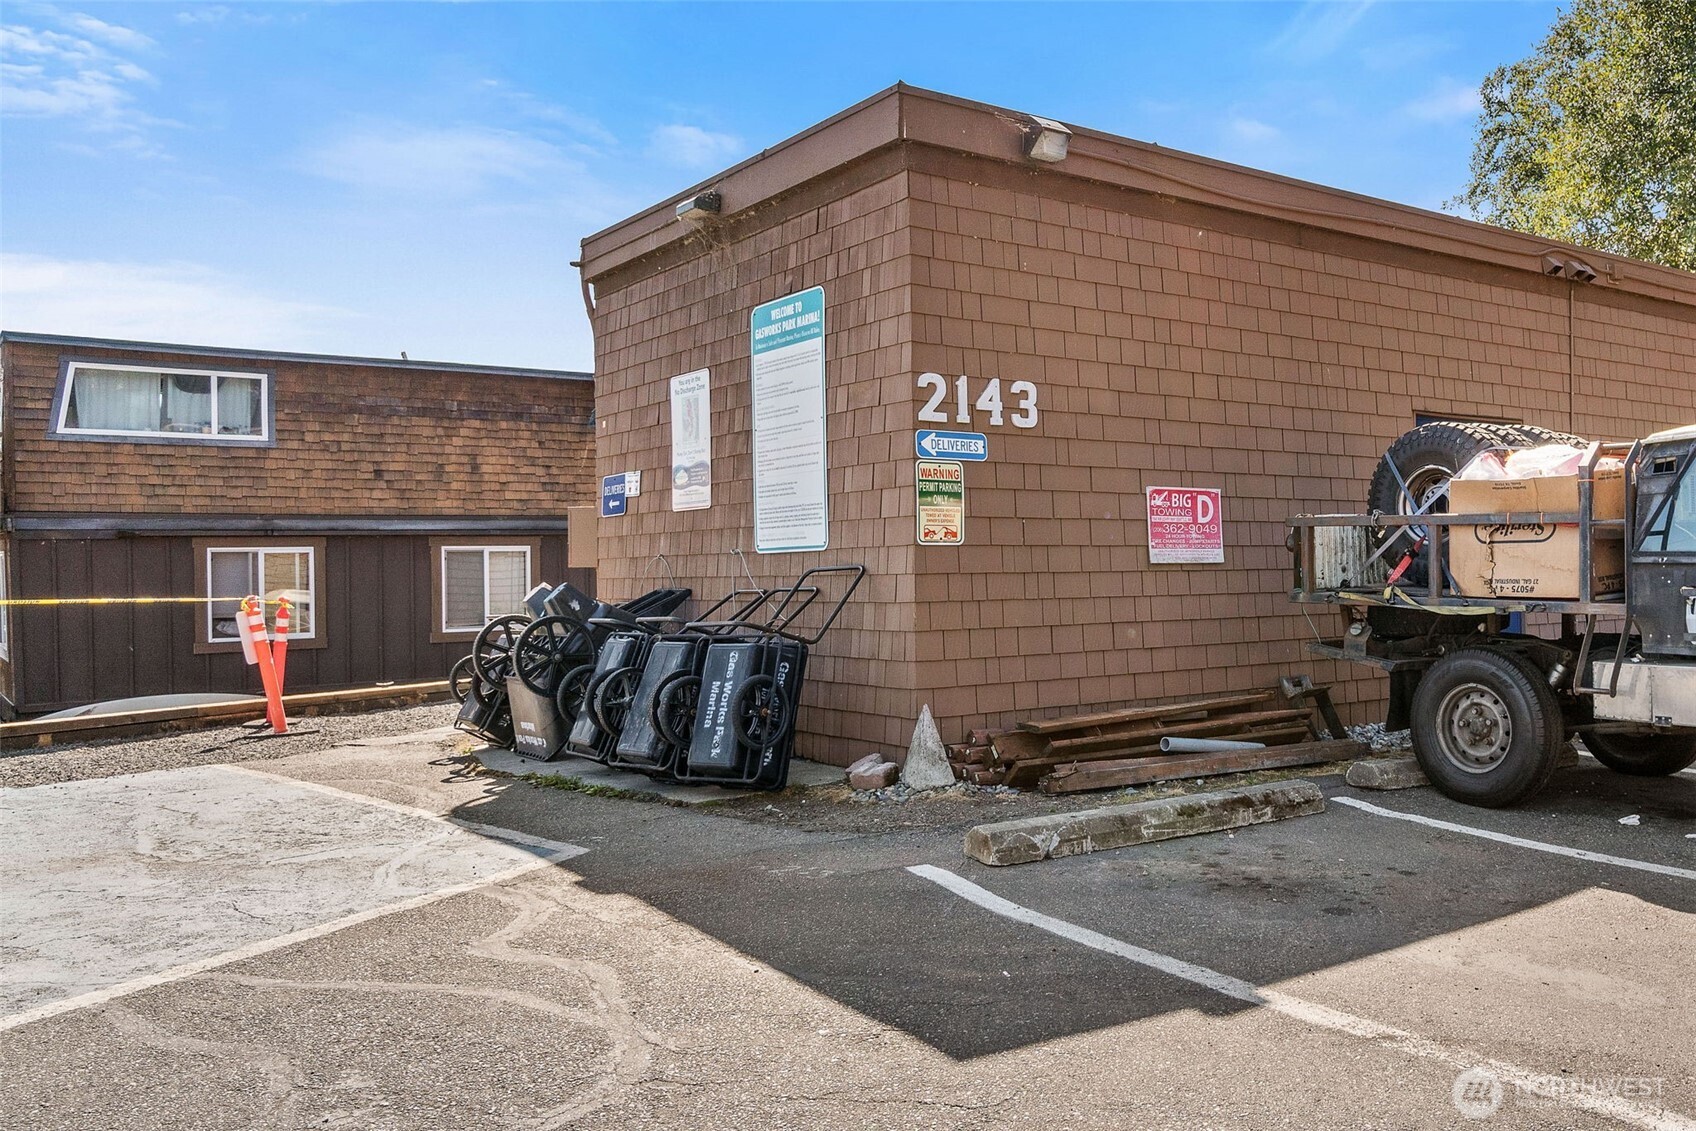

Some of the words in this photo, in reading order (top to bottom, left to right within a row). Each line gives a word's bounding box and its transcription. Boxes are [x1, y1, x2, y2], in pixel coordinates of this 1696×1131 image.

[771, 304, 795, 320] WELCOME
[795, 301, 803, 314] TO
[755, 322, 782, 340] GASWORKS
[782, 317, 796, 332] PARK
[797, 310, 820, 328] MARINA!
[917, 372, 1038, 428] 2143
[931, 439, 979, 453] DELIVERIES
[920, 468, 960, 479] WARNING
[919, 481, 938, 492] PERMIT
[939, 482, 962, 493] PARKING
[932, 495, 949, 504] ONLY
[1172, 493, 1191, 507] BIG
[1152, 508, 1192, 516] TOWING
[1163, 523, 1218, 534] 362-9049
[1511, 585, 1535, 593] #5075
[726, 650, 739, 678] Gas
[777, 661, 789, 688] Gas
[704, 681, 721, 728] Marina
[717, 680, 734, 724] Works
